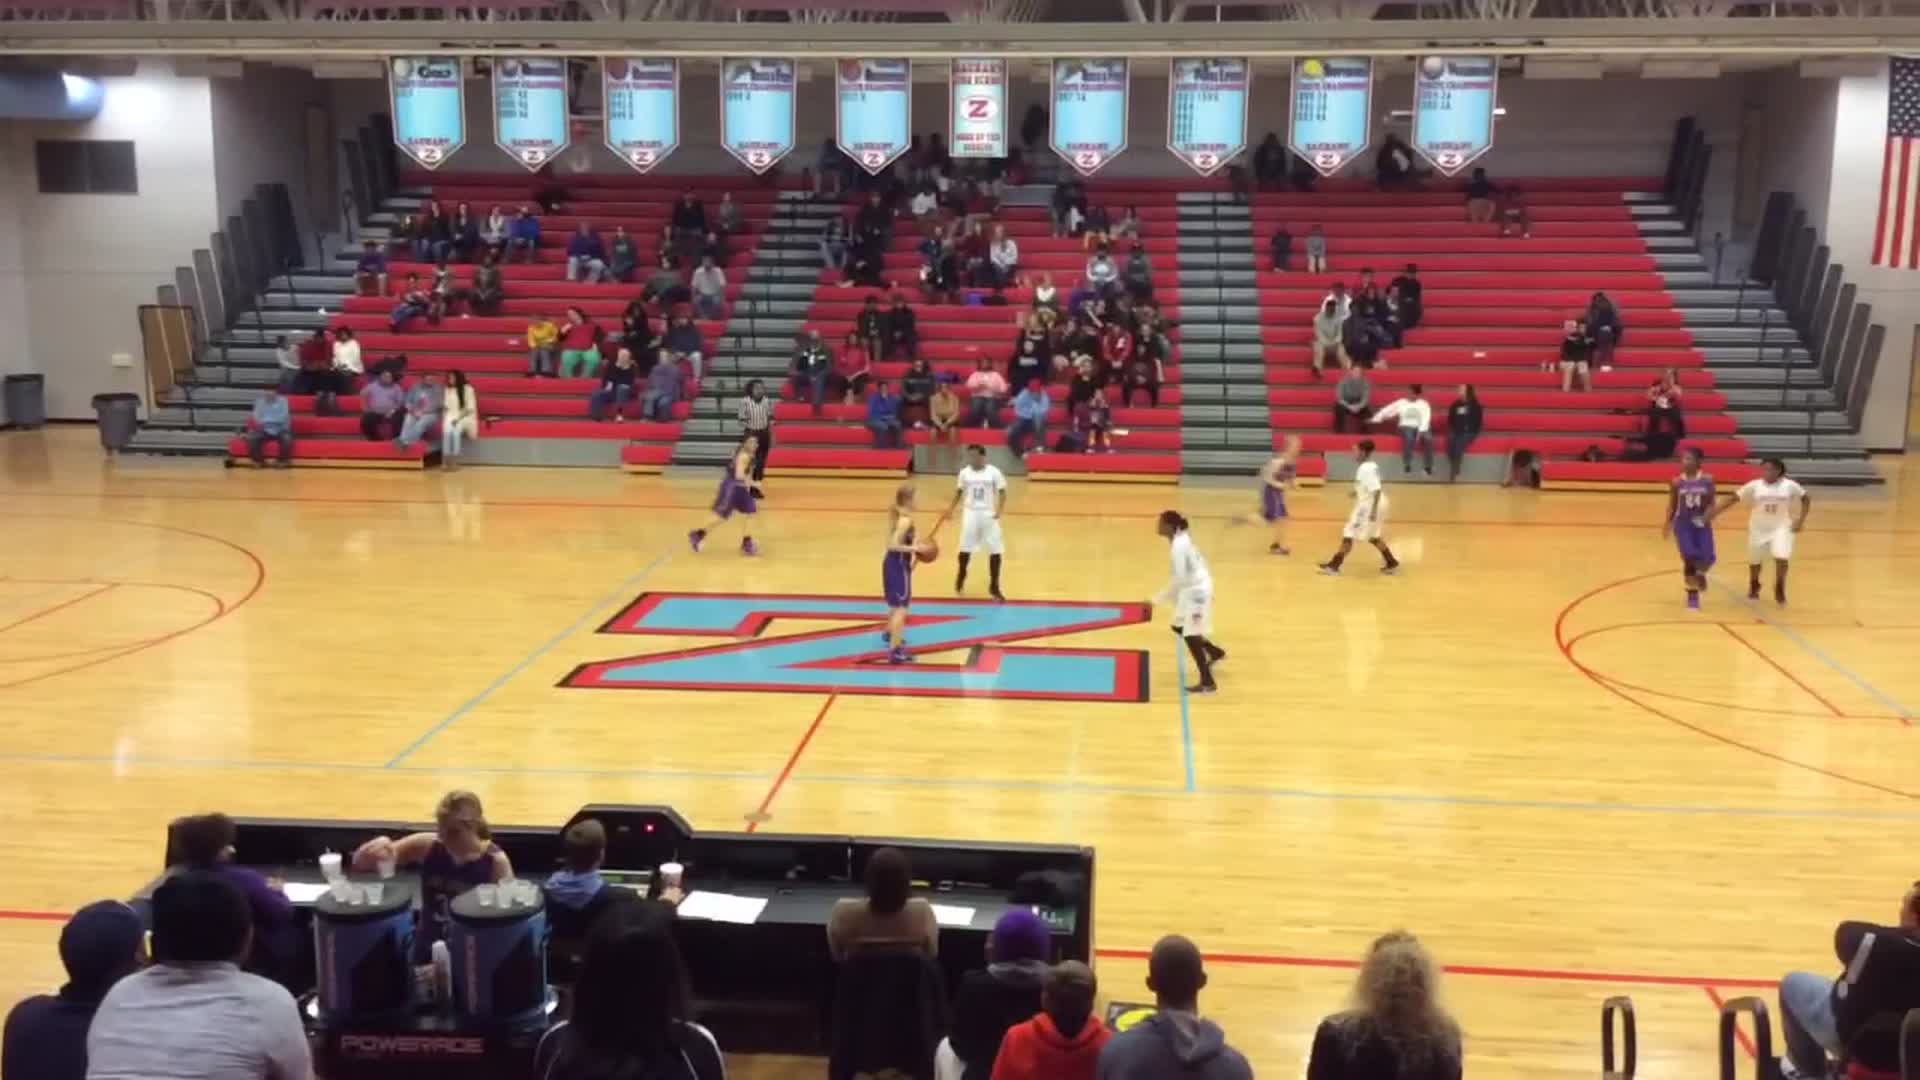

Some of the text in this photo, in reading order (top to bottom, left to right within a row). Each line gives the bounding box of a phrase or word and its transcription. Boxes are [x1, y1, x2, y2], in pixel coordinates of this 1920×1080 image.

[969, 100, 988, 118] Z
[868, 153, 880, 164] Z
[555, 592, 1152, 703] Z
[340, 1034, 485, 1054] POWERADE
